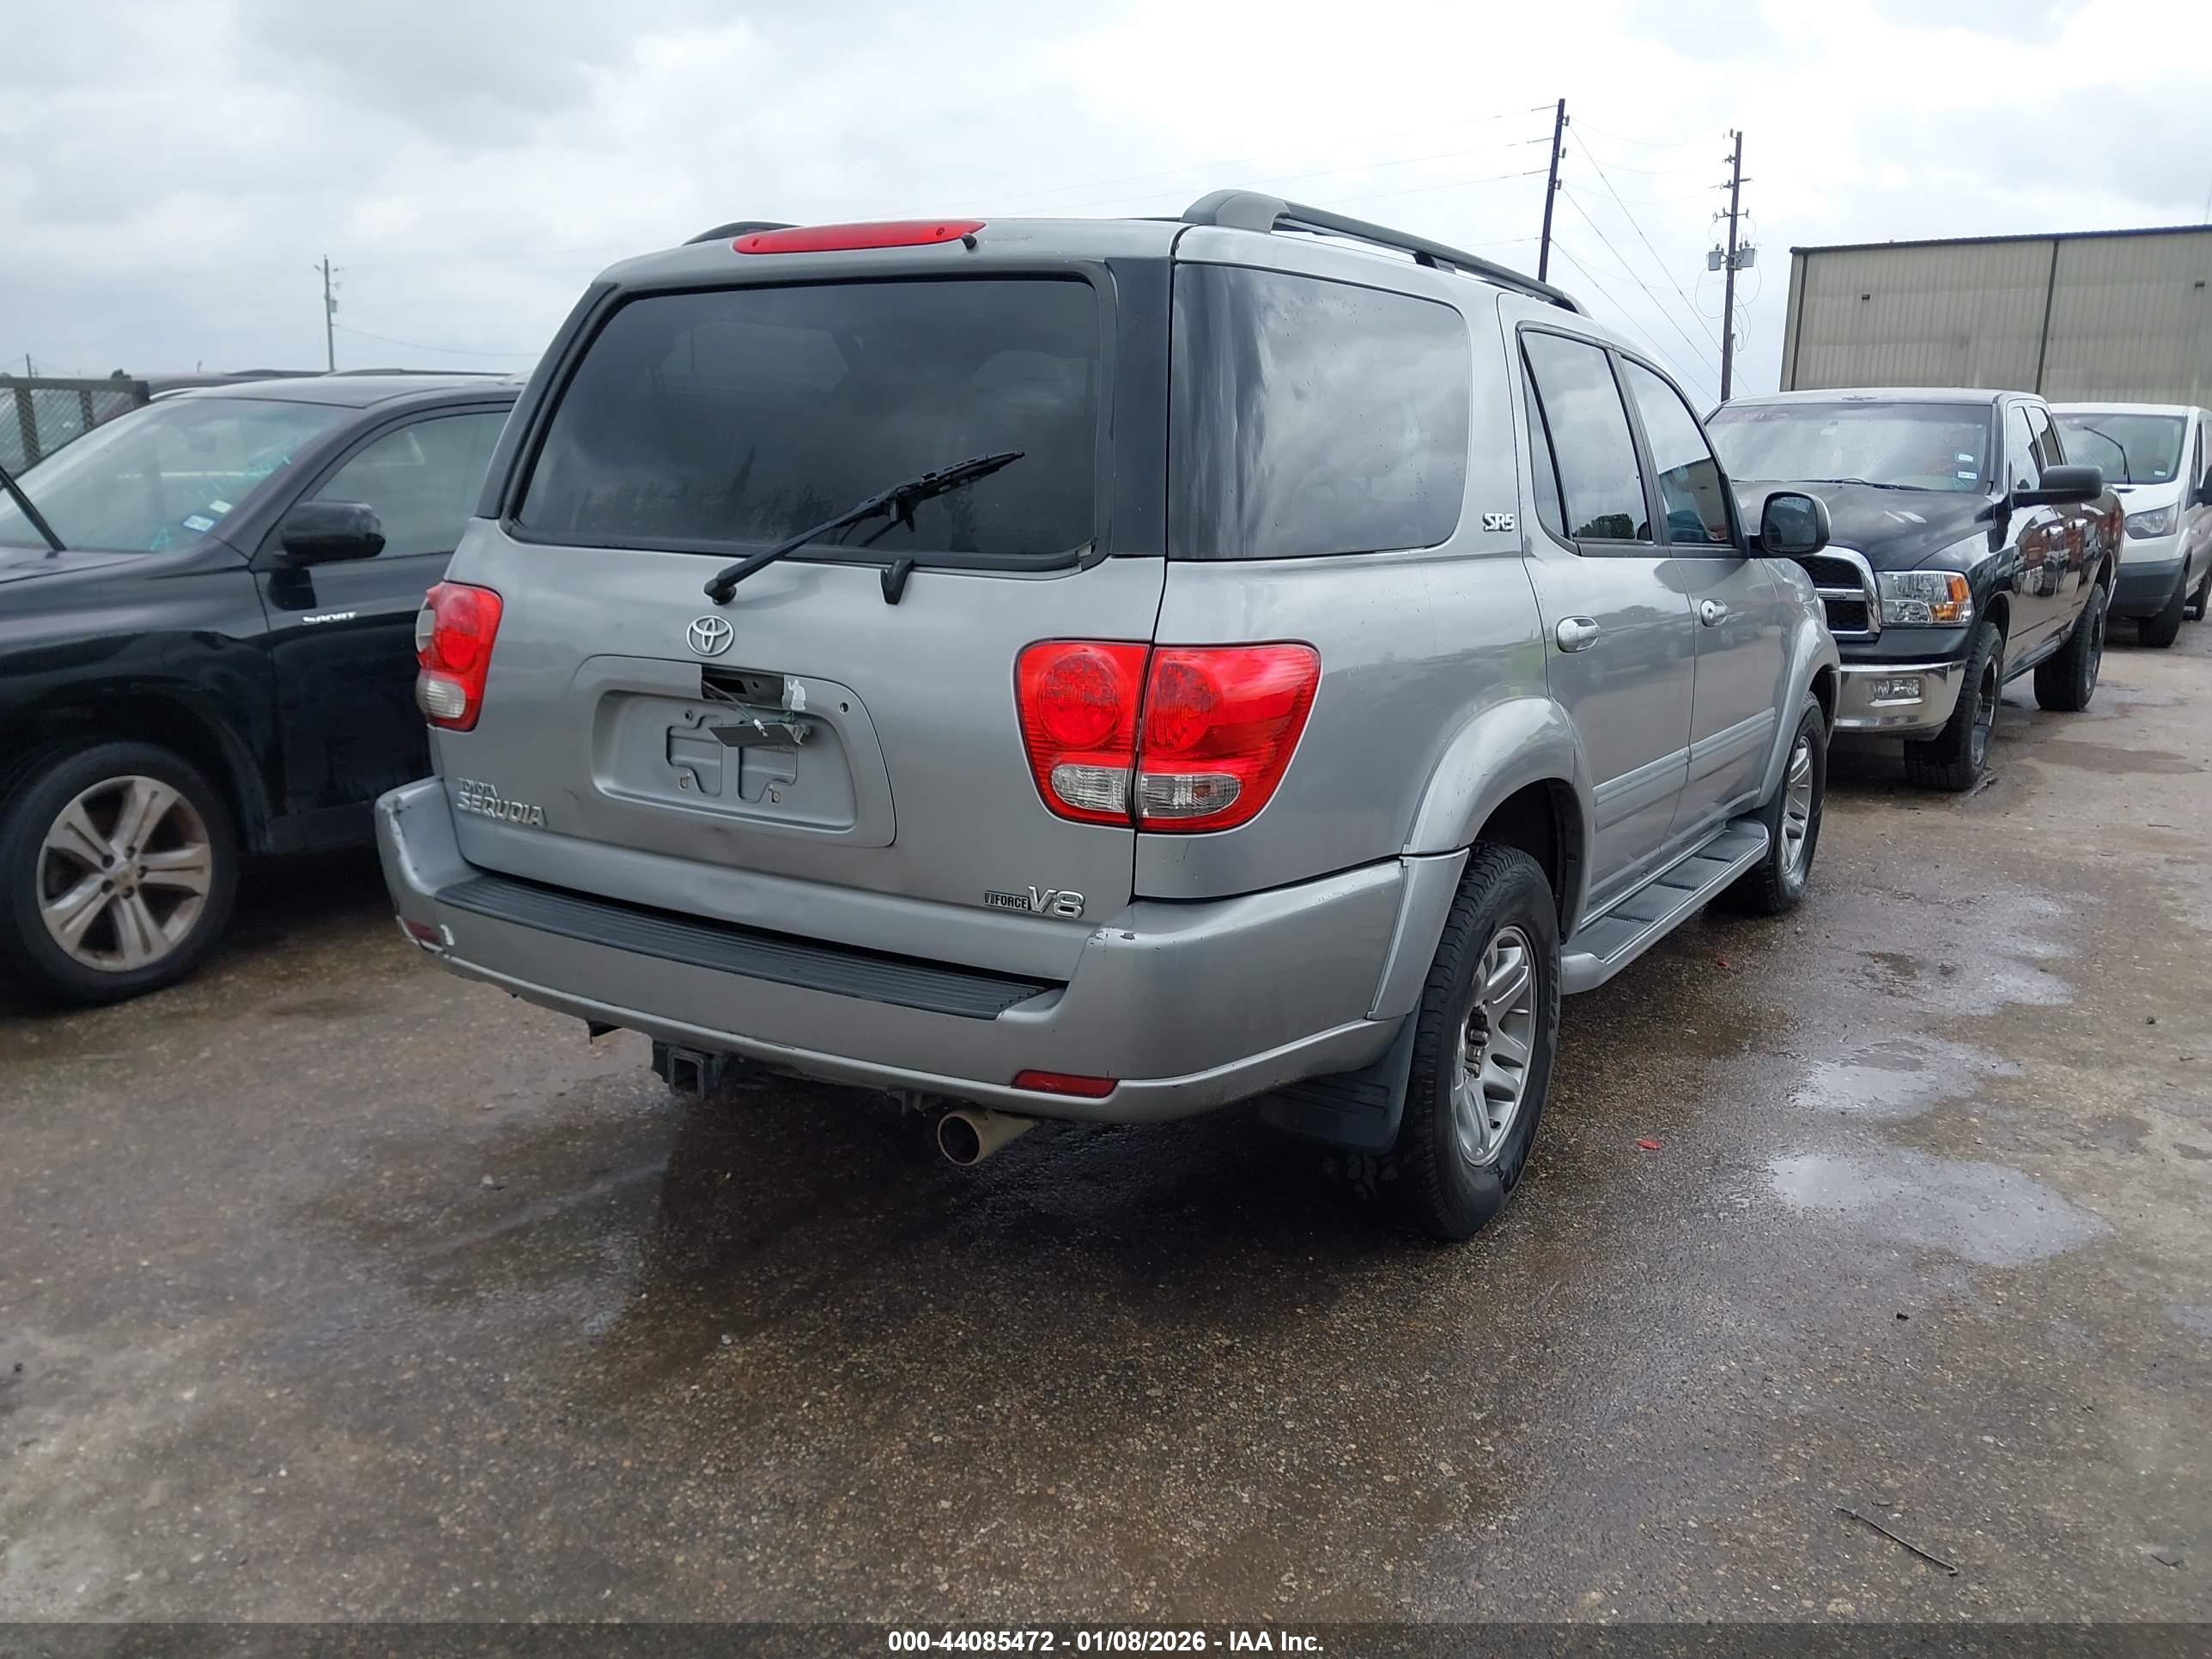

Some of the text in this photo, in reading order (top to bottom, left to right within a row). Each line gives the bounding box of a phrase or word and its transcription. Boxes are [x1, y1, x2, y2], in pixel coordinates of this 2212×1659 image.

[1483, 513, 1515, 532] SR5
[458, 777, 497, 797] TOYOTA
[457, 791, 546, 826] SEQUOIA
[1028, 885, 1085, 918] V8
